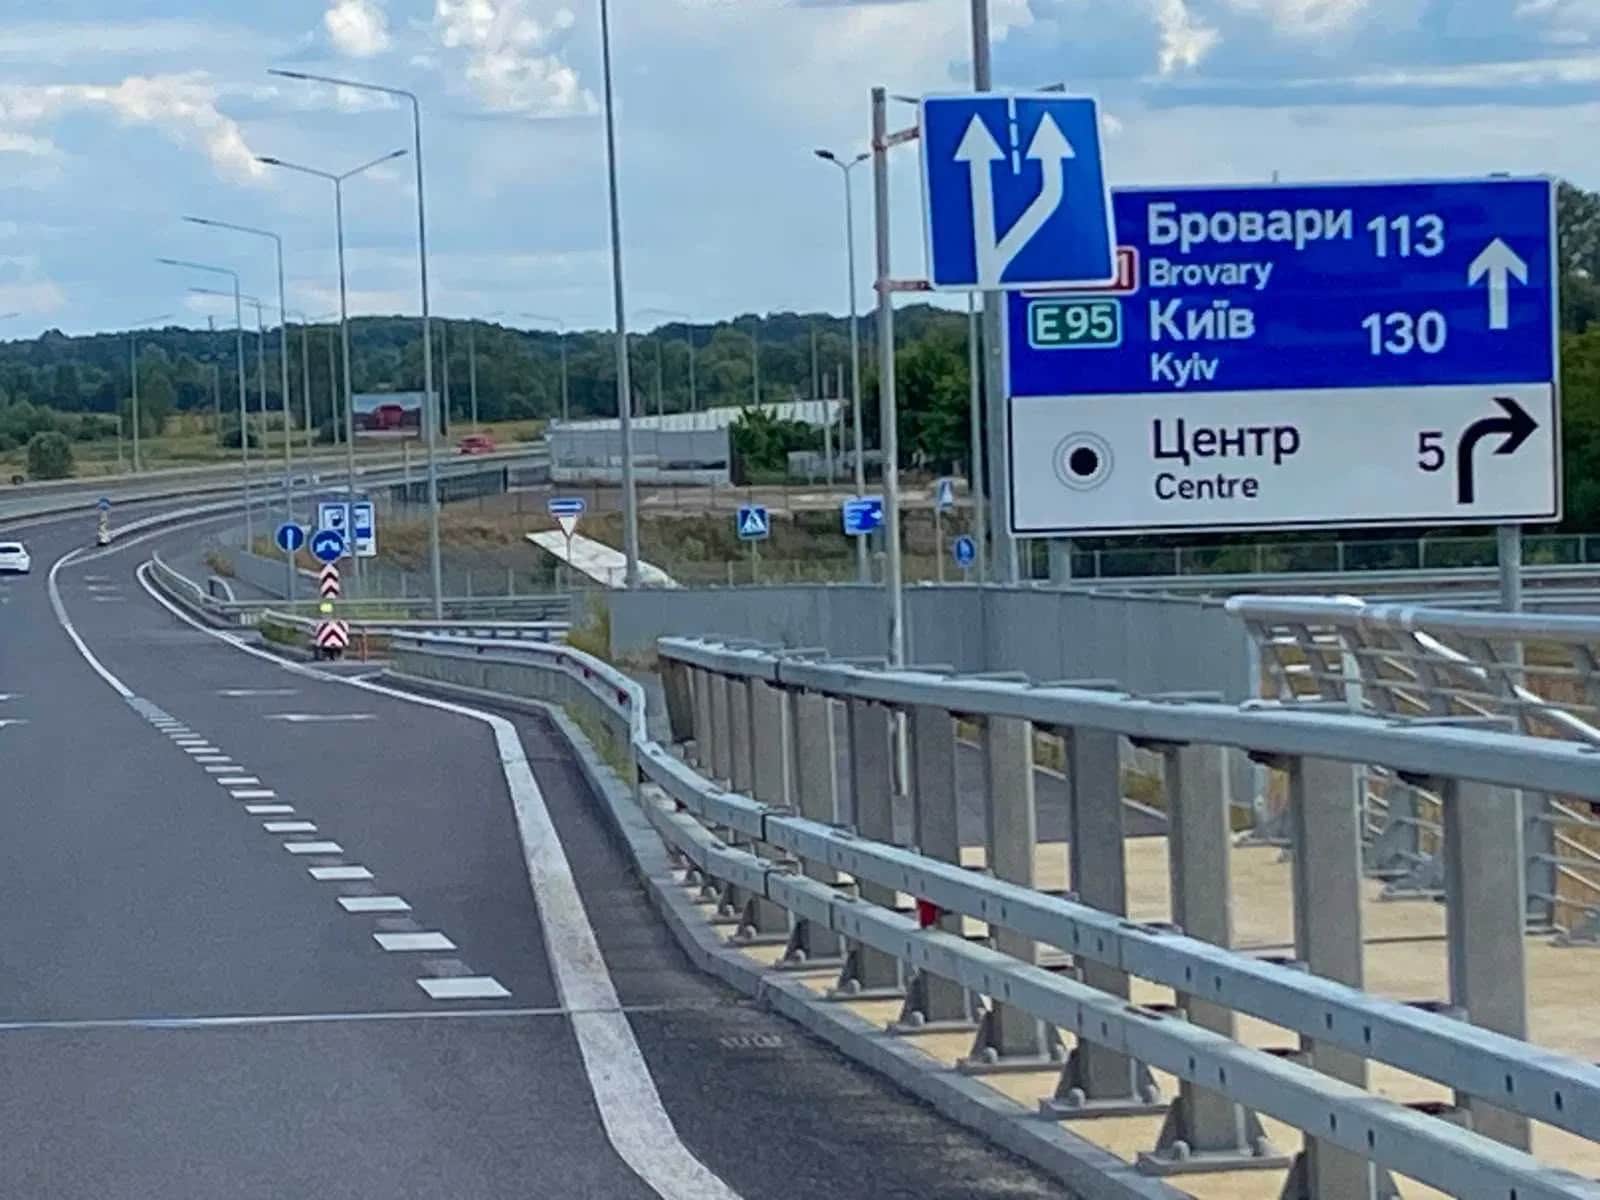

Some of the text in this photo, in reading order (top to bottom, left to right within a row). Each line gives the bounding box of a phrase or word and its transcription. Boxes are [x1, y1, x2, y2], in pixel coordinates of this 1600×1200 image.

[1147, 203, 1445, 258] Бровари 113
[1148, 258, 1272, 290] Brovary
[1149, 298, 1447, 355] Київ 130
[1151, 352, 1218, 387] Kyiv
[1152, 418, 1445, 473] Центр 5
[1155, 473, 1259, 500] Centre
